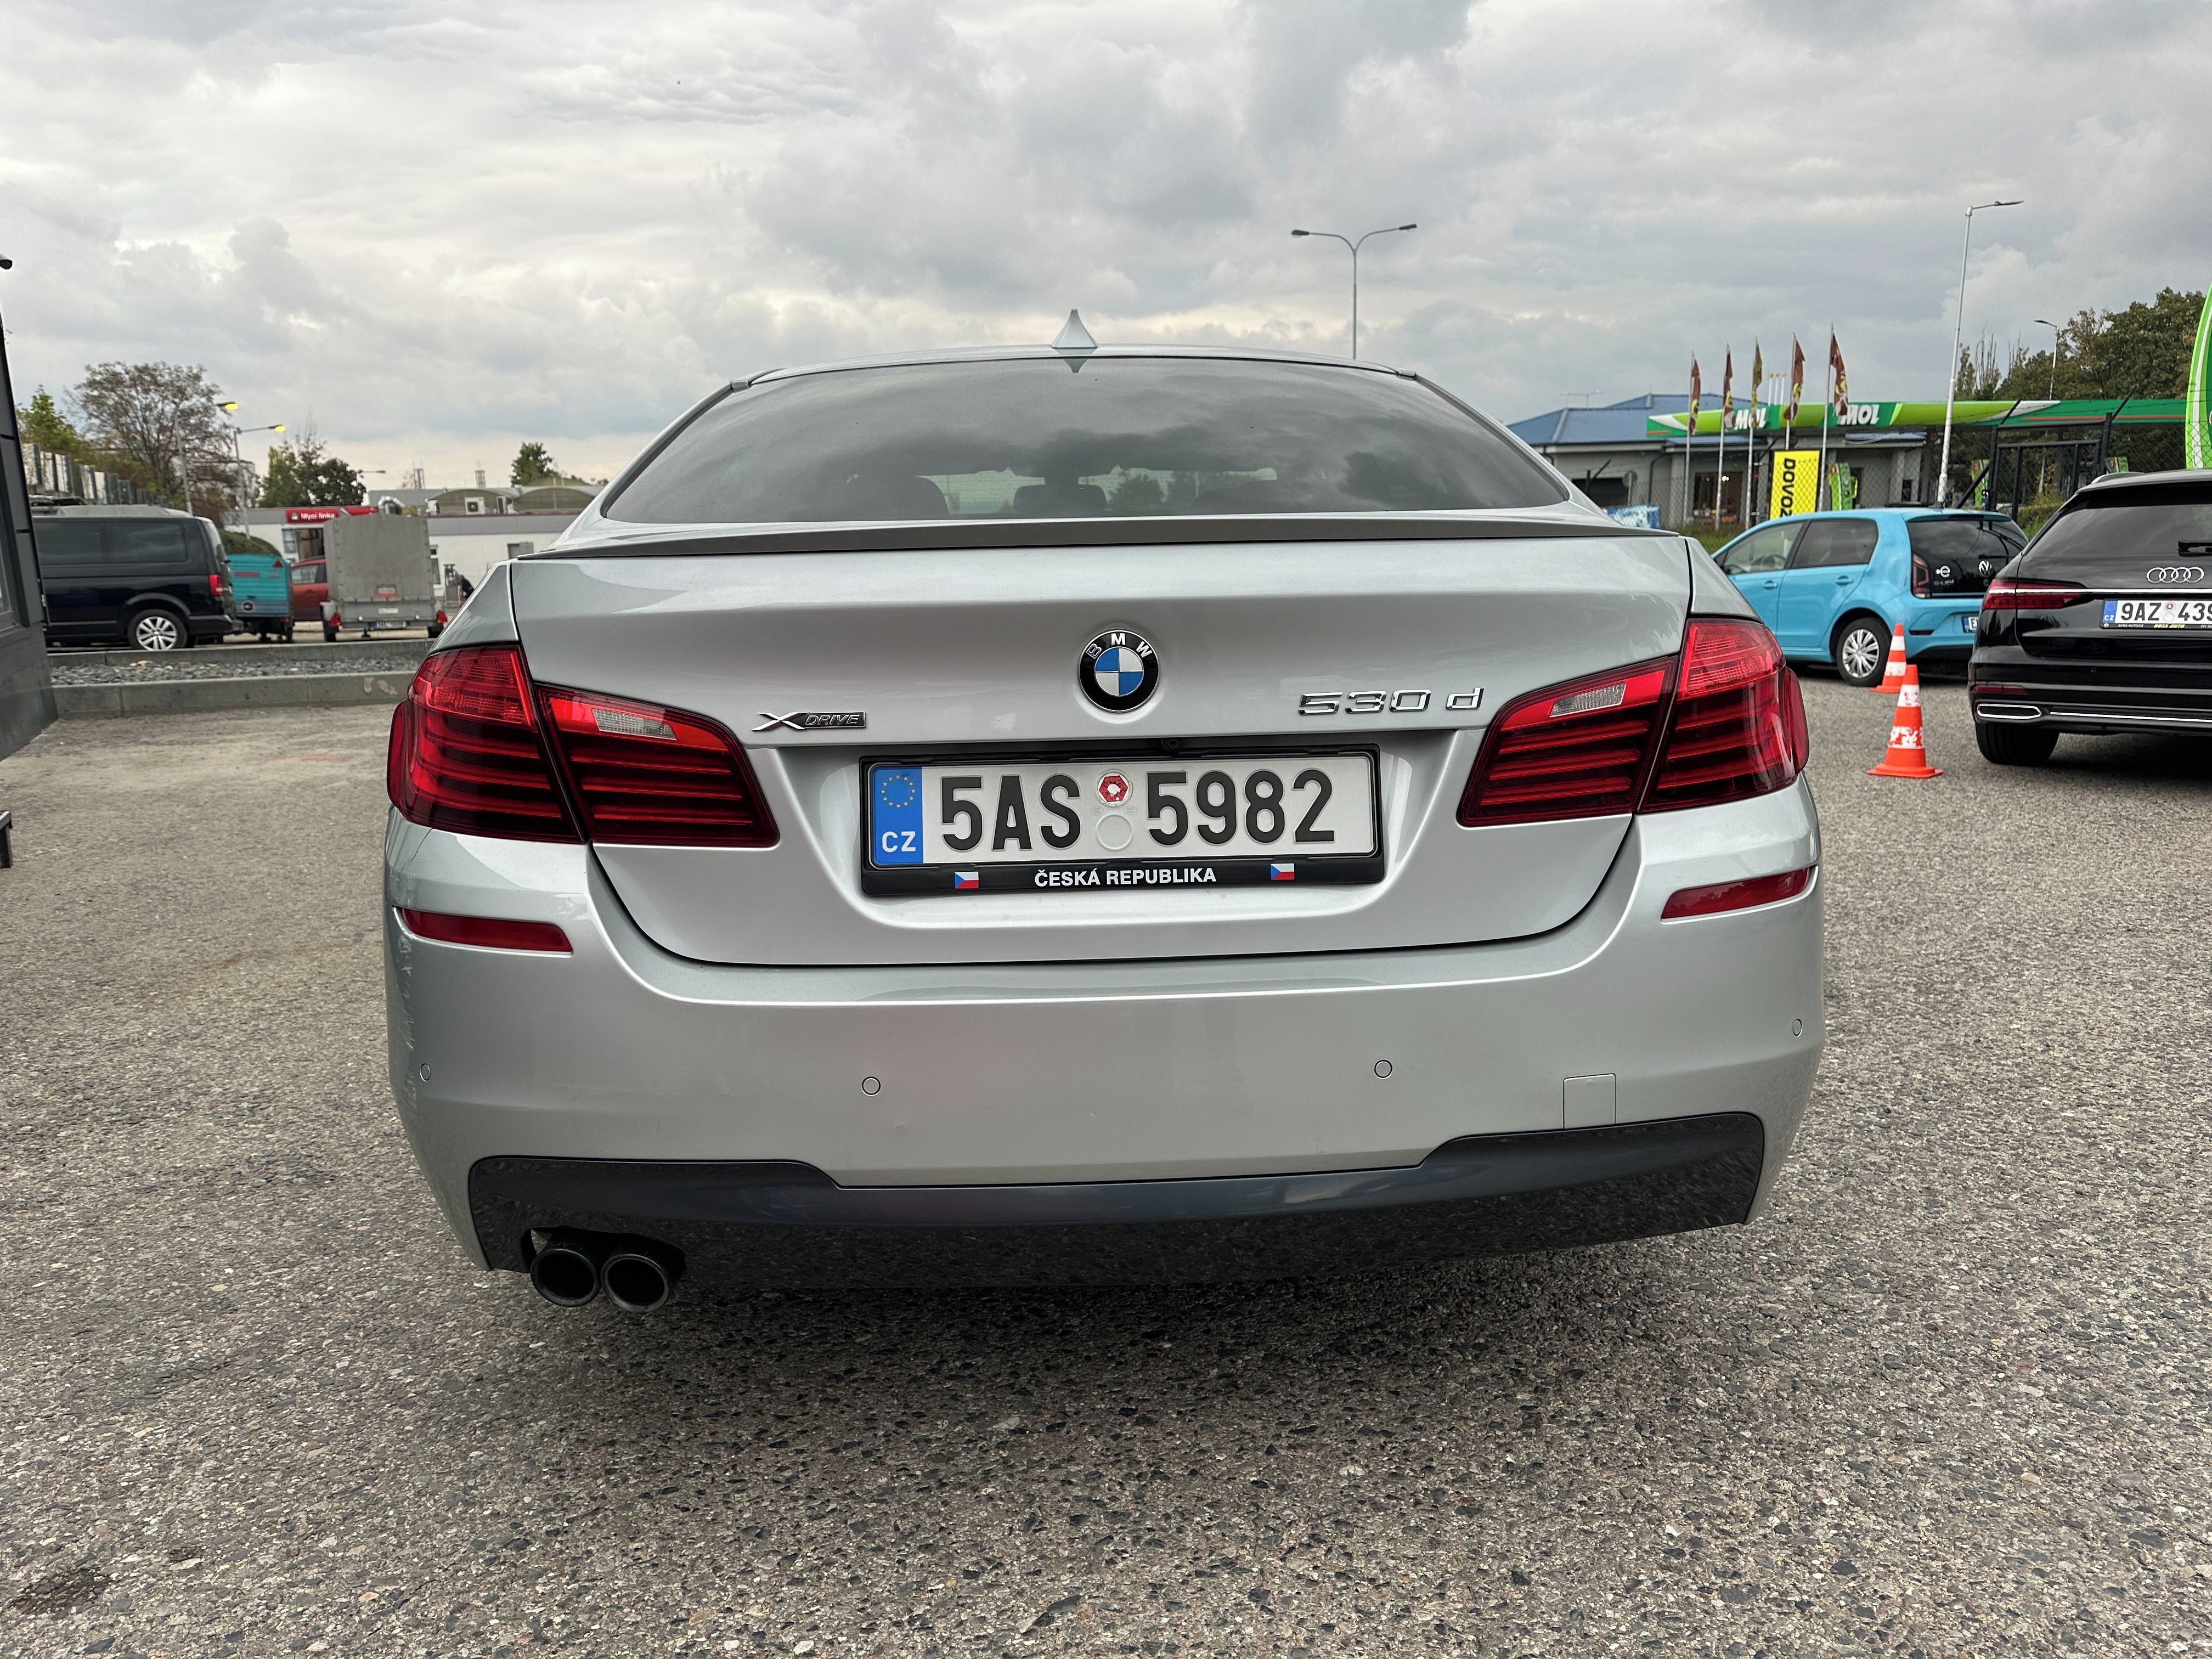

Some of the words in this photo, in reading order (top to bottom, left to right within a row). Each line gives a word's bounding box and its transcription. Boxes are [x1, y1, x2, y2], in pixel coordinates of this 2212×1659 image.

[1837, 404, 1880, 425] MOL
[2121, 602, 2162, 621] 9AZ
[1086, 633, 1153, 659] BMW
[1298, 689, 1432, 715] 530
[1445, 687, 1485, 710] d
[882, 831, 916, 853] CZ
[941, 775, 1081, 852] 5AS
[1147, 769, 1335, 846] 5982
[1035, 868, 1101, 887] ČESKÁ
[1106, 867, 1217, 885] REPUBLIKA
